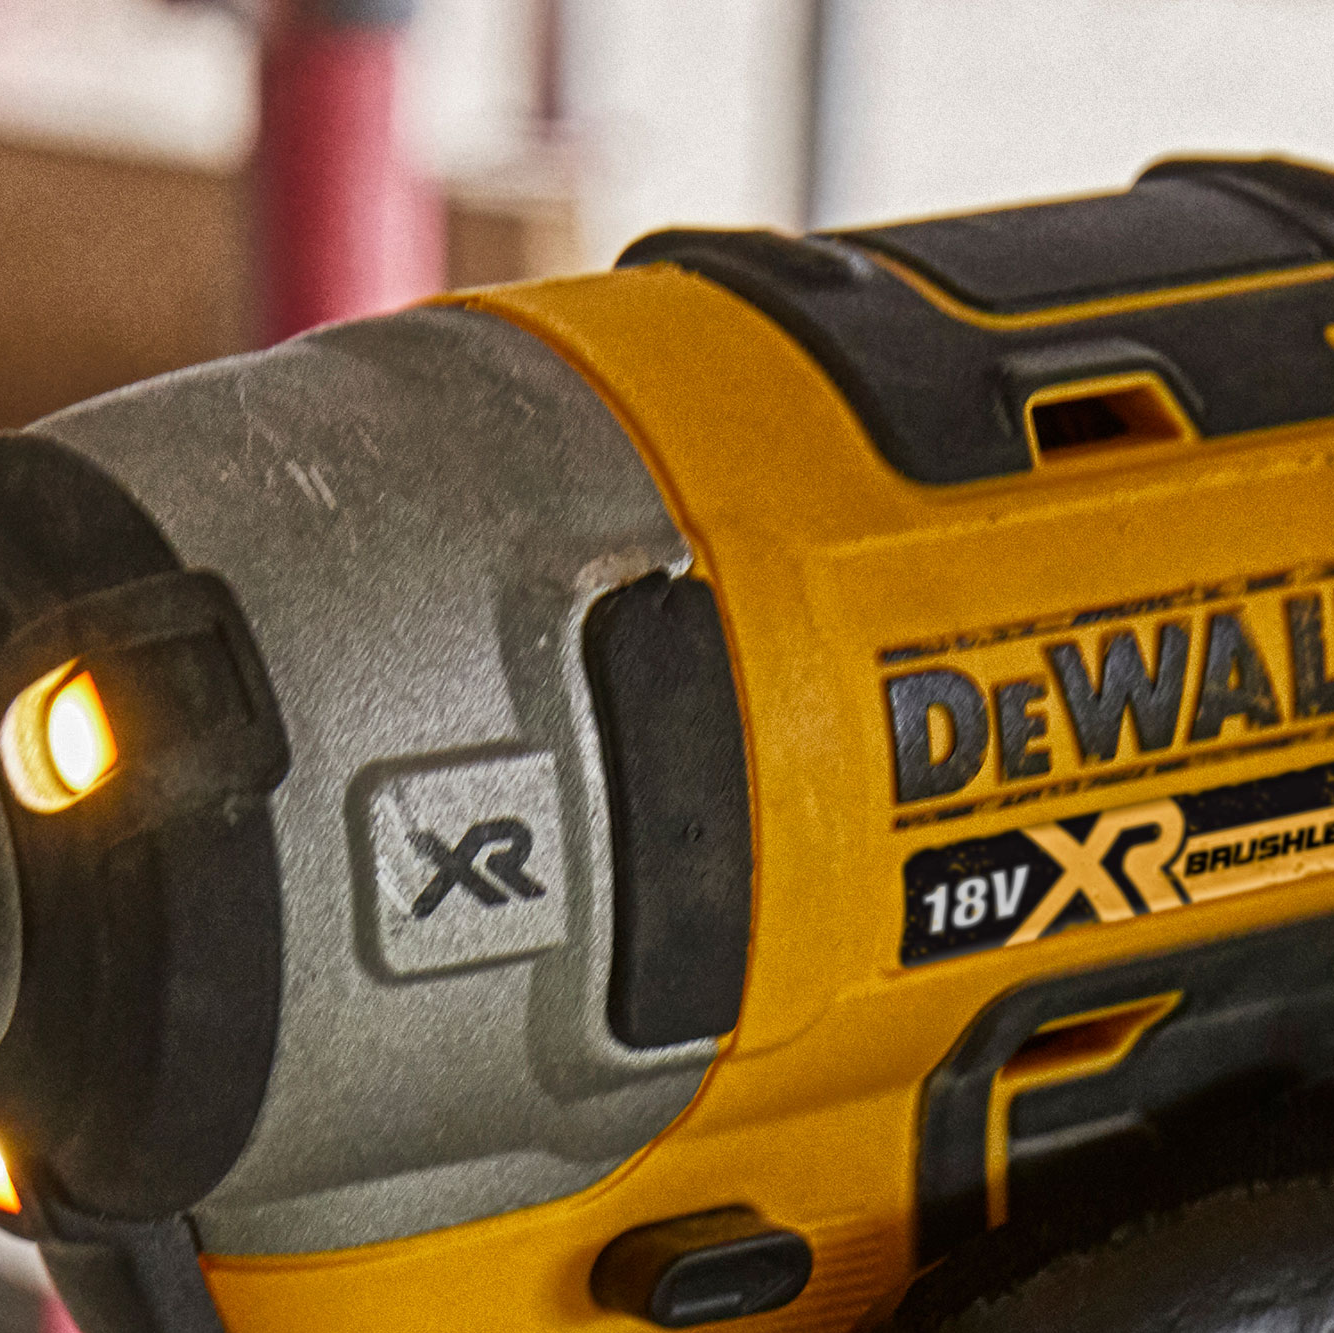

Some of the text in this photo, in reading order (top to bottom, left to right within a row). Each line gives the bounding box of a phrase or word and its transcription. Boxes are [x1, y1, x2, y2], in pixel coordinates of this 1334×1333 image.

[407, 814, 548, 920] XR
[921, 863, 1030, 936] 18V
[1004, 797, 1189, 948] XR
